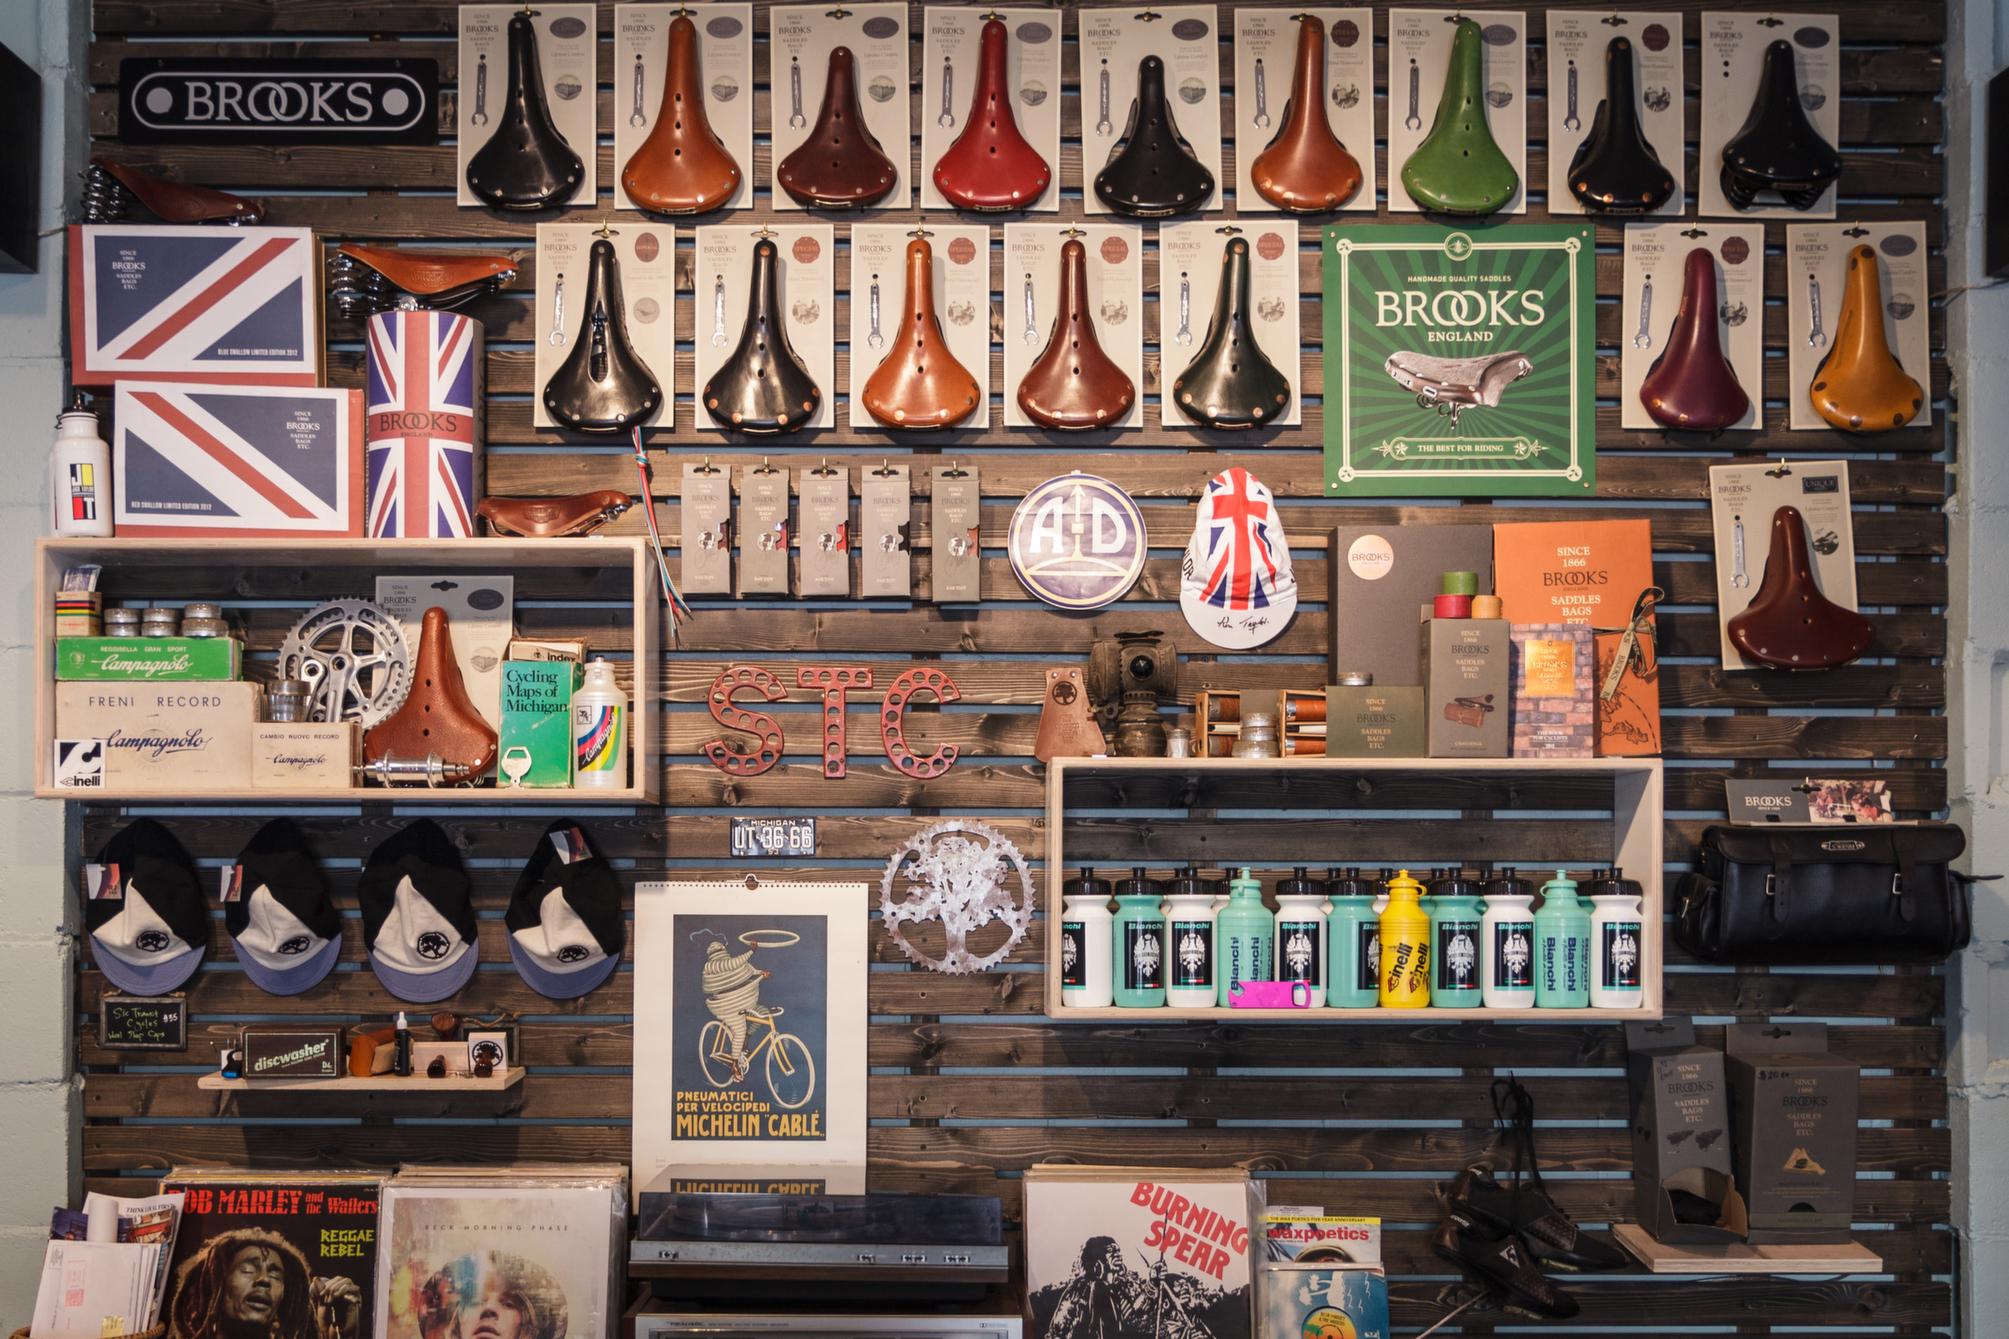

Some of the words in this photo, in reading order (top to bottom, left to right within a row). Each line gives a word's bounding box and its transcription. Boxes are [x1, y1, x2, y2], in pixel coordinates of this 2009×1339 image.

[466, 25, 499, 33] BROOKS
[779, 27, 812, 35] BROOKS
[1088, 29, 1121, 37] BROOKS
[1397, 29, 1430, 38] BROOKS
[1710, 31, 1743, 40] BROOKS
[184, 81, 374, 121] BROOKS
[544, 244, 577, 252] BROOKS
[1796, 244, 1828, 252] BROOKS
[112, 262, 146, 270] BROOKS
[1375, 290, 1545, 327] BROOKS
[1428, 331, 1493, 342] ENGLAND
[286, 422, 320, 431] BROOKS
[380, 413, 457, 432] BROOKS
[1718, 486, 1751, 494] BROOKS
[1351, 552, 1391, 562] BROOKS
[1557, 546, 1591, 557] SINCE
[1563, 558, 1586, 568] 1866
[1543, 571, 1608, 587] BROOKS
[383, 596, 416, 604] BROOKS
[1551, 594, 1601, 606] SADDLES
[1562, 606, 1592, 617] BAGS
[1451, 645, 1490, 654] BROOKS
[97, 654, 192, 677] Campagnolo
[506, 670, 558, 686] Cycling
[506, 684, 541, 699] Maps
[544, 683, 558, 697] of
[89, 697, 135, 707] FRENI
[157, 696, 221, 707] RECORD
[506, 699, 568, 714] Michigan
[704, 665, 961, 779] STC
[1356, 713, 1396, 723] BROOKS
[99, 728, 209, 757] Campagnolo
[270, 753, 327, 768] Campagnolo
[1745, 796, 1792, 806] BROOKS
[1230, 936, 1239, 991] Bianchi
[1252, 936, 1260, 982] ianchi
[1547, 937, 1556, 991] Bianchi
[1568, 937, 1577, 991] Bianchi
[1677, 1064, 1701, 1072] SINCE
[1668, 1081, 1714, 1094] BROOKS
[677, 1091, 753, 1102] PNEUMATICI
[1783, 1096, 1828, 1106] BROOKS
[677, 1102, 699, 1113] PER
[702, 1102, 770, 1113] VELOCIPEDI
[1674, 1099, 1710, 1108] SADDLES
[1682, 1107, 1703, 1115] BAGS
[1786, 1112, 1822, 1120] SADDLES
[1685, 1115, 1703, 1123] ETC.
[1793, 1120, 1815, 1128] BAGS
[676, 1114, 760, 1138] MICHELIN
[167, 1189, 213, 1215] OB
[218, 1189, 302, 1215] MARLEY
[305, 1191, 323, 1203] and
[306, 1203, 321, 1215] the
[328, 1197, 377, 1215] Wailers
[1129, 1182, 1248, 1256] BURNING
[321, 1228, 374, 1243] REGGAE
[1268, 1226, 1369, 1243] waxpoetics
[321, 1243, 365, 1257] REBEL
[1144, 1221, 1230, 1280] SPEAR
